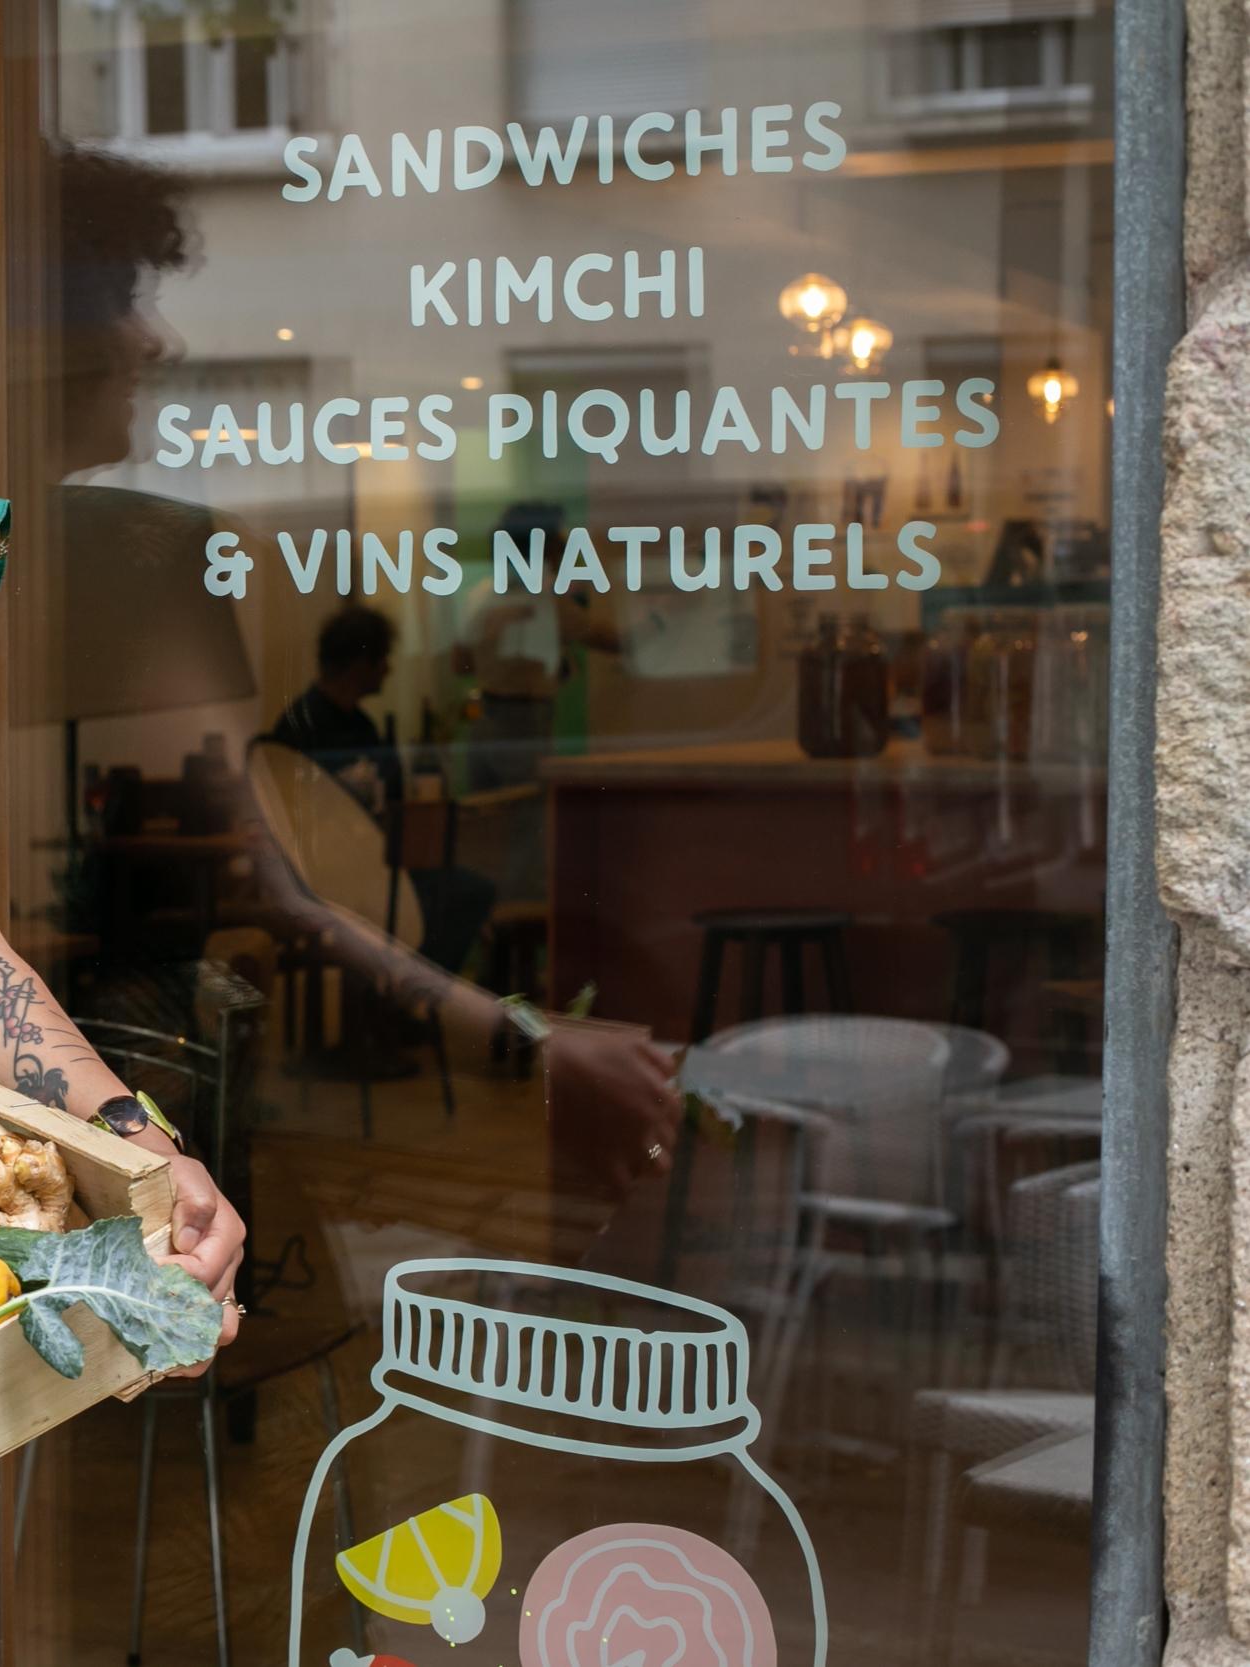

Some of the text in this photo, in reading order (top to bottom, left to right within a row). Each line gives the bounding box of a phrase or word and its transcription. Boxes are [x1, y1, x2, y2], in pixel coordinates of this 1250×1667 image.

[281, 101, 847, 202] SANDWICHES
[409, 246, 705, 326] KIMCHI
[155, 377, 1001, 469] SAUCES PIQUANTES
[203, 520, 942, 599] & VINS NATURELS
